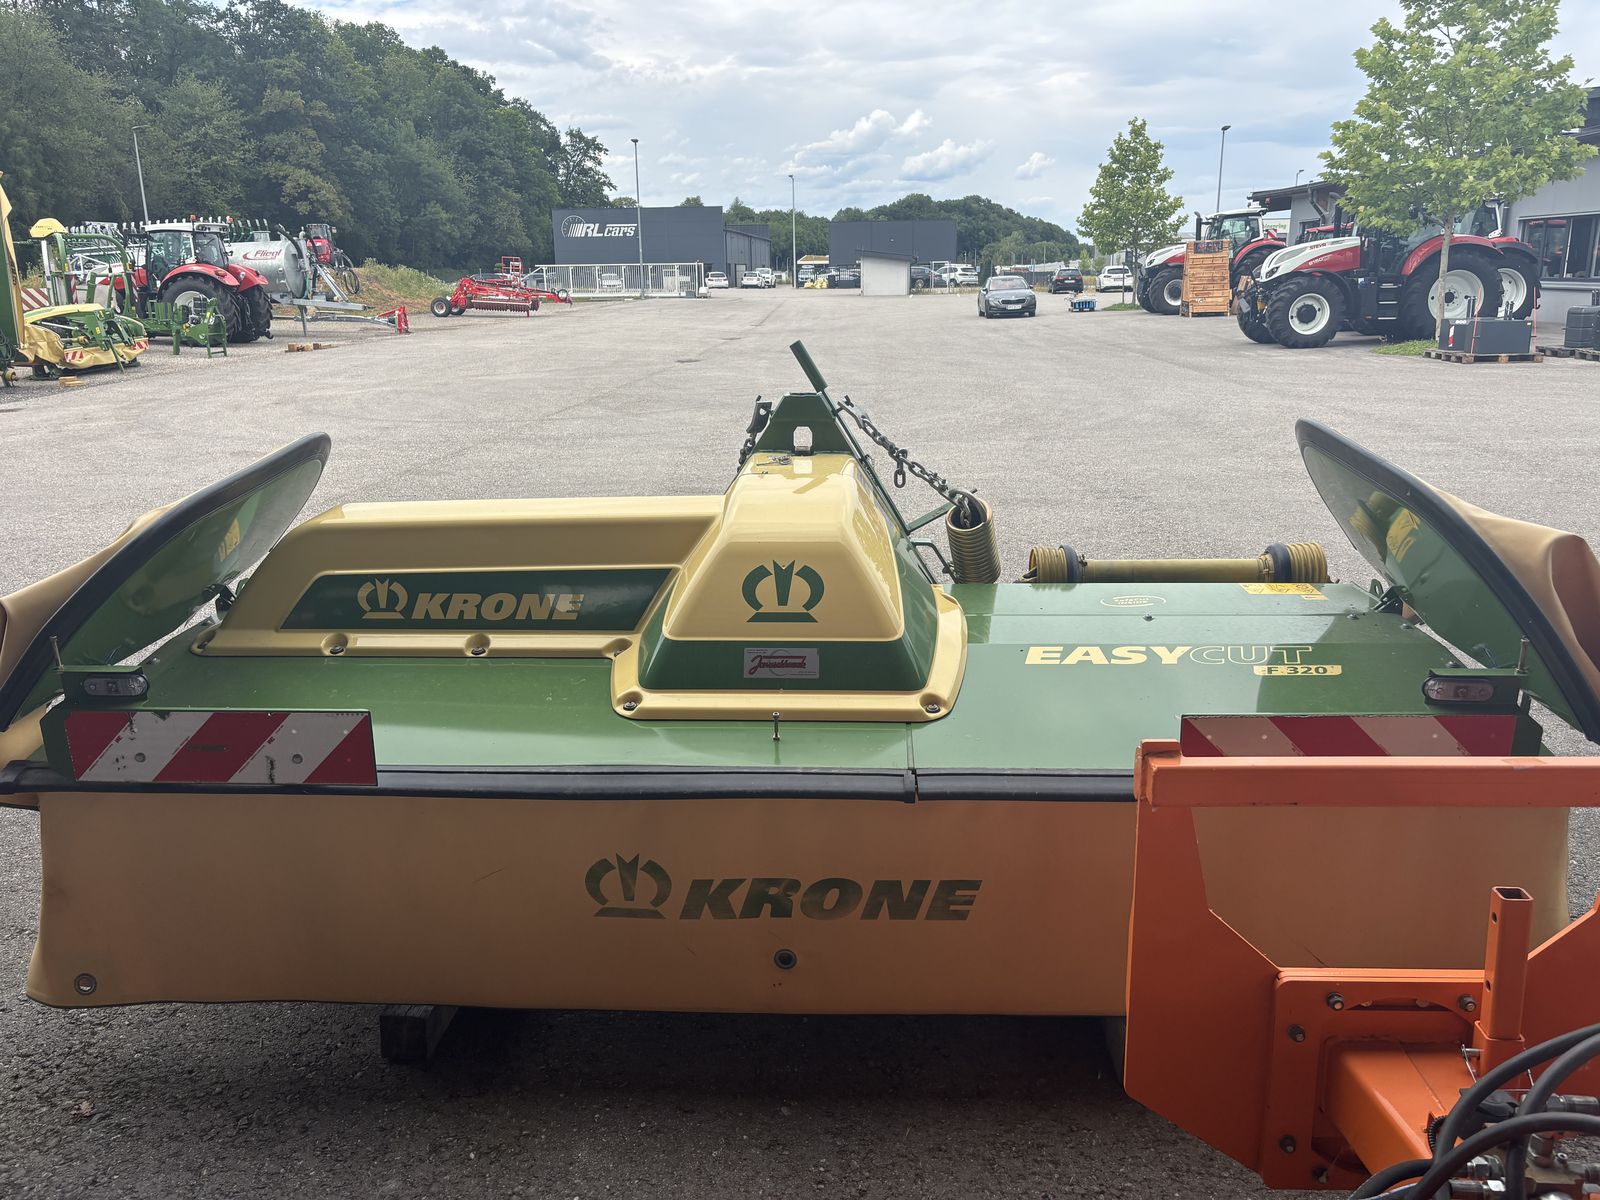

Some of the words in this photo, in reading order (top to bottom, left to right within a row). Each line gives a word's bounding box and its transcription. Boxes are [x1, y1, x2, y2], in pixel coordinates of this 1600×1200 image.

[582, 223, 603, 237] RL
[604, 224, 637, 237] cars
[255, 249, 282, 259] Fliegl
[411, 592, 585, 621] KRONE
[1024, 645, 1313, 665] EASYCUT
[1266, 666, 1279, 675] F
[1286, 666, 1328, 675] 320
[679, 877, 983, 921] KRONE
